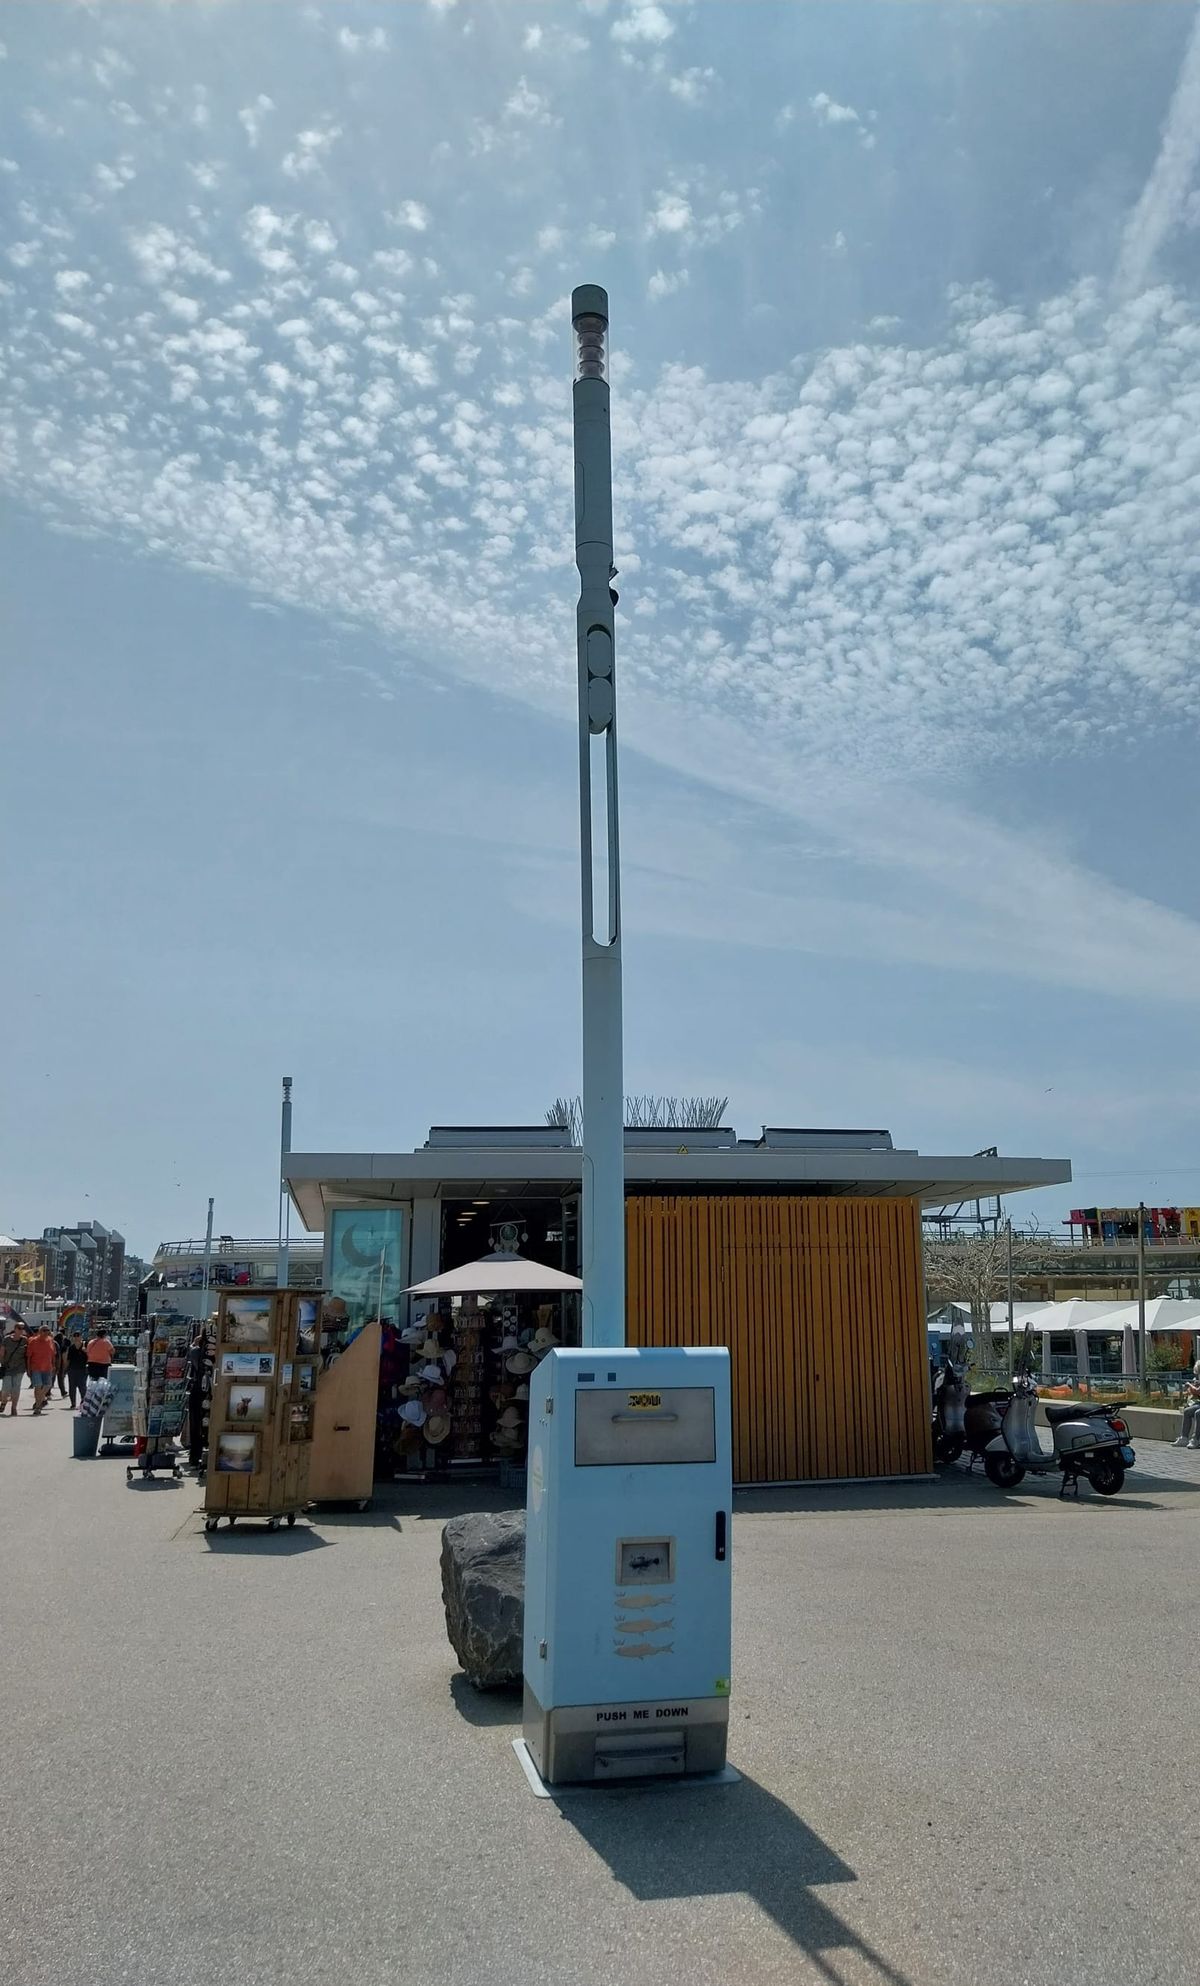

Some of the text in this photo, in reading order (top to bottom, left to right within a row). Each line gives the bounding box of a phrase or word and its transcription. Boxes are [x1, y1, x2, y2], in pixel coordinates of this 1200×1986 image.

[596, 1707, 689, 1721] PUSH ME DOWN
